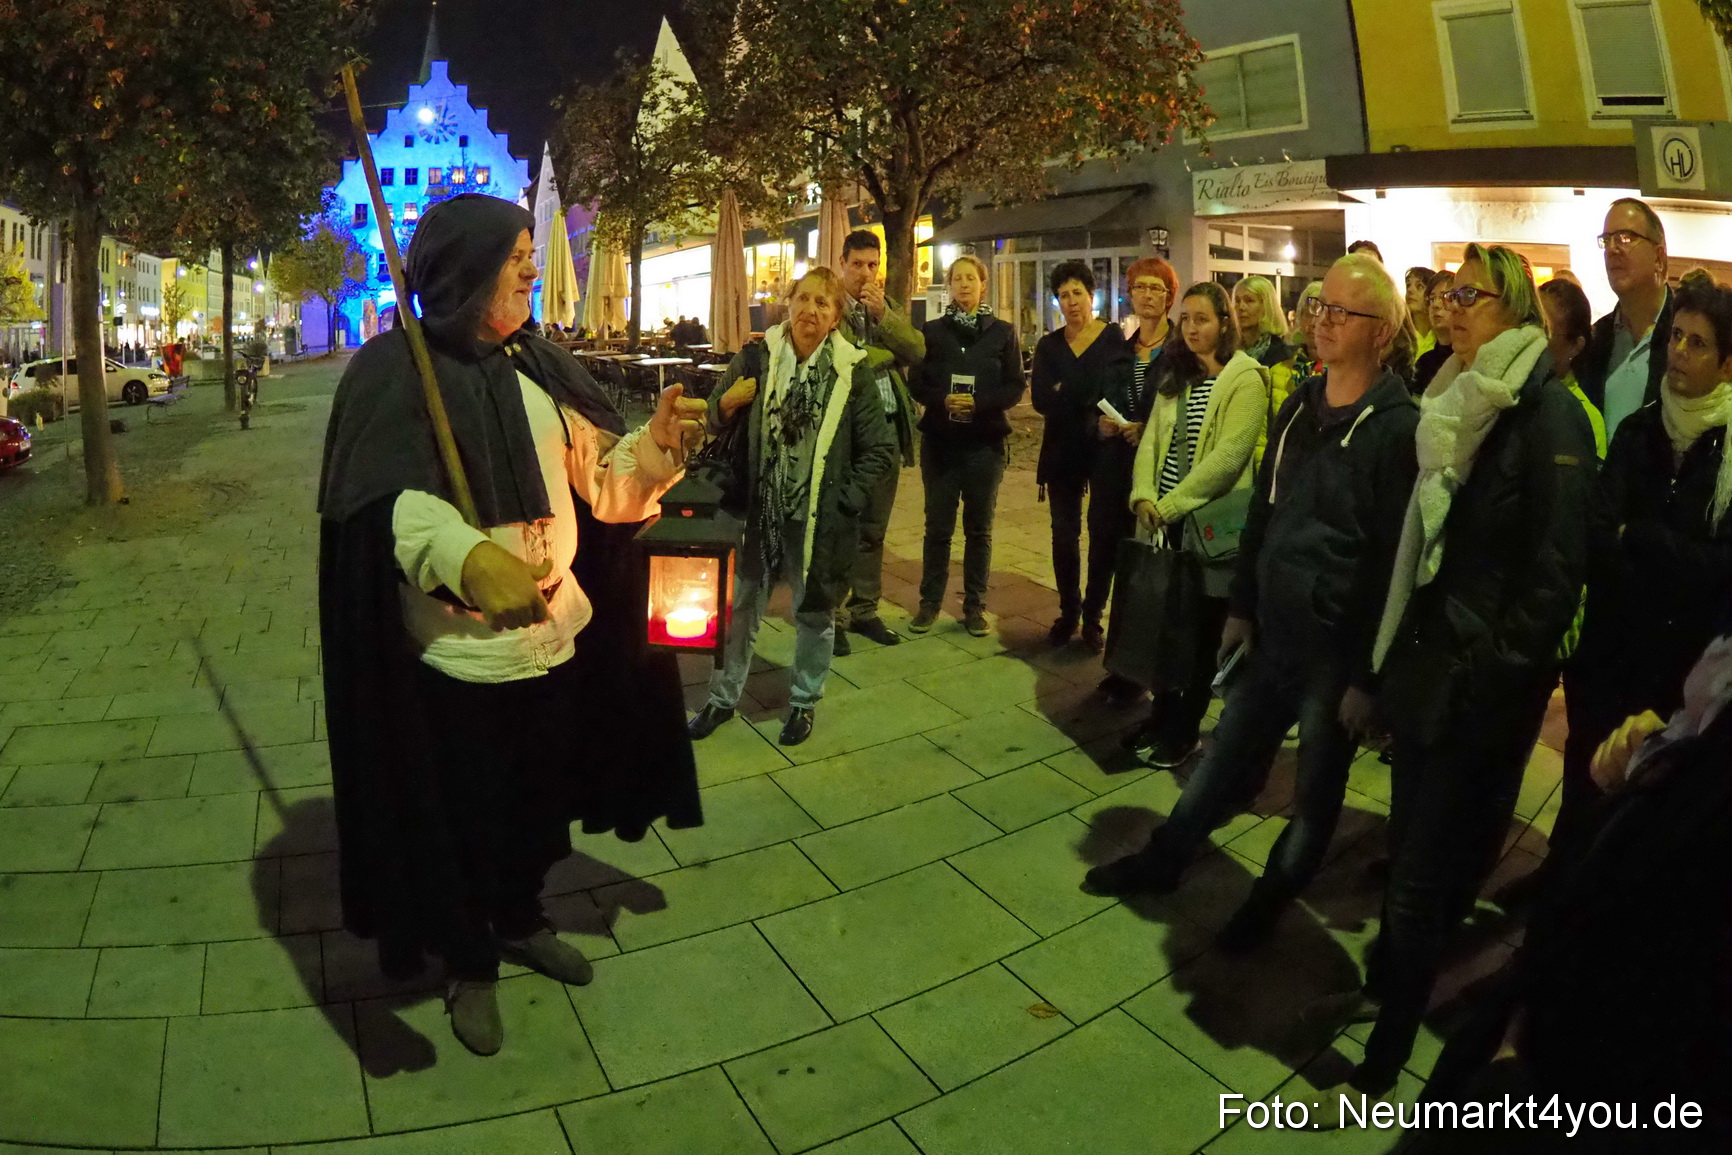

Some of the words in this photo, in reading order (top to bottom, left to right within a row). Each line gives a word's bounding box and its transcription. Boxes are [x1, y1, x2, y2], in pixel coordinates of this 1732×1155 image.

[1197, 169, 1251, 200] Rialto
[1254, 172, 1274, 189] Eis
[1276, 170, 1327, 193] Boutiqu
